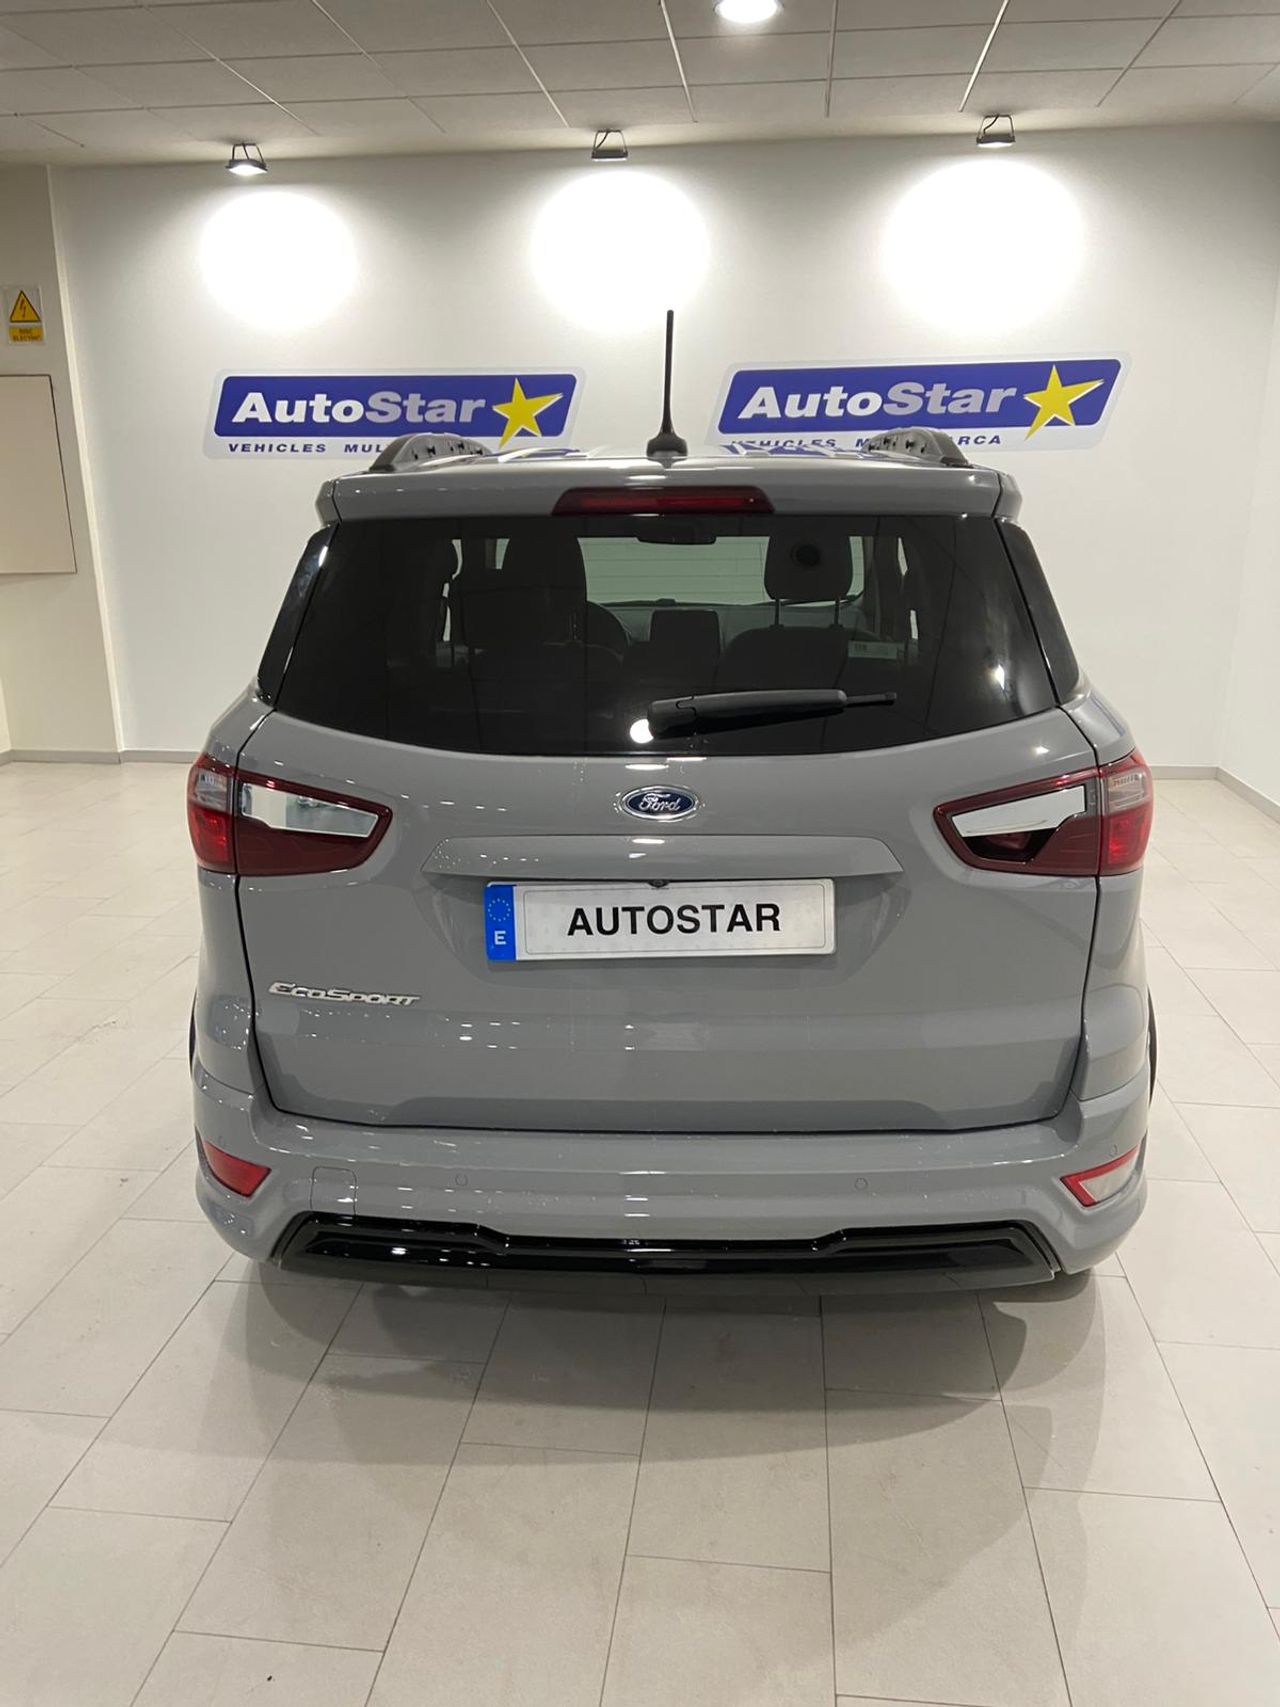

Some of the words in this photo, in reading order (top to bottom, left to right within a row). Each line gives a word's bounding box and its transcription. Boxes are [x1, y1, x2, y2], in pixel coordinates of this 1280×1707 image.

[232, 391, 485, 423] AutoStar
[738, 382, 1016, 419] AutoStar
[229, 443, 326, 452] VEHICLES
[731, 438, 836, 448] HICLES
[639, 793, 681, 811] Ford
[567, 903, 781, 936] AUTOSTAR
[494, 930, 507, 945] E
